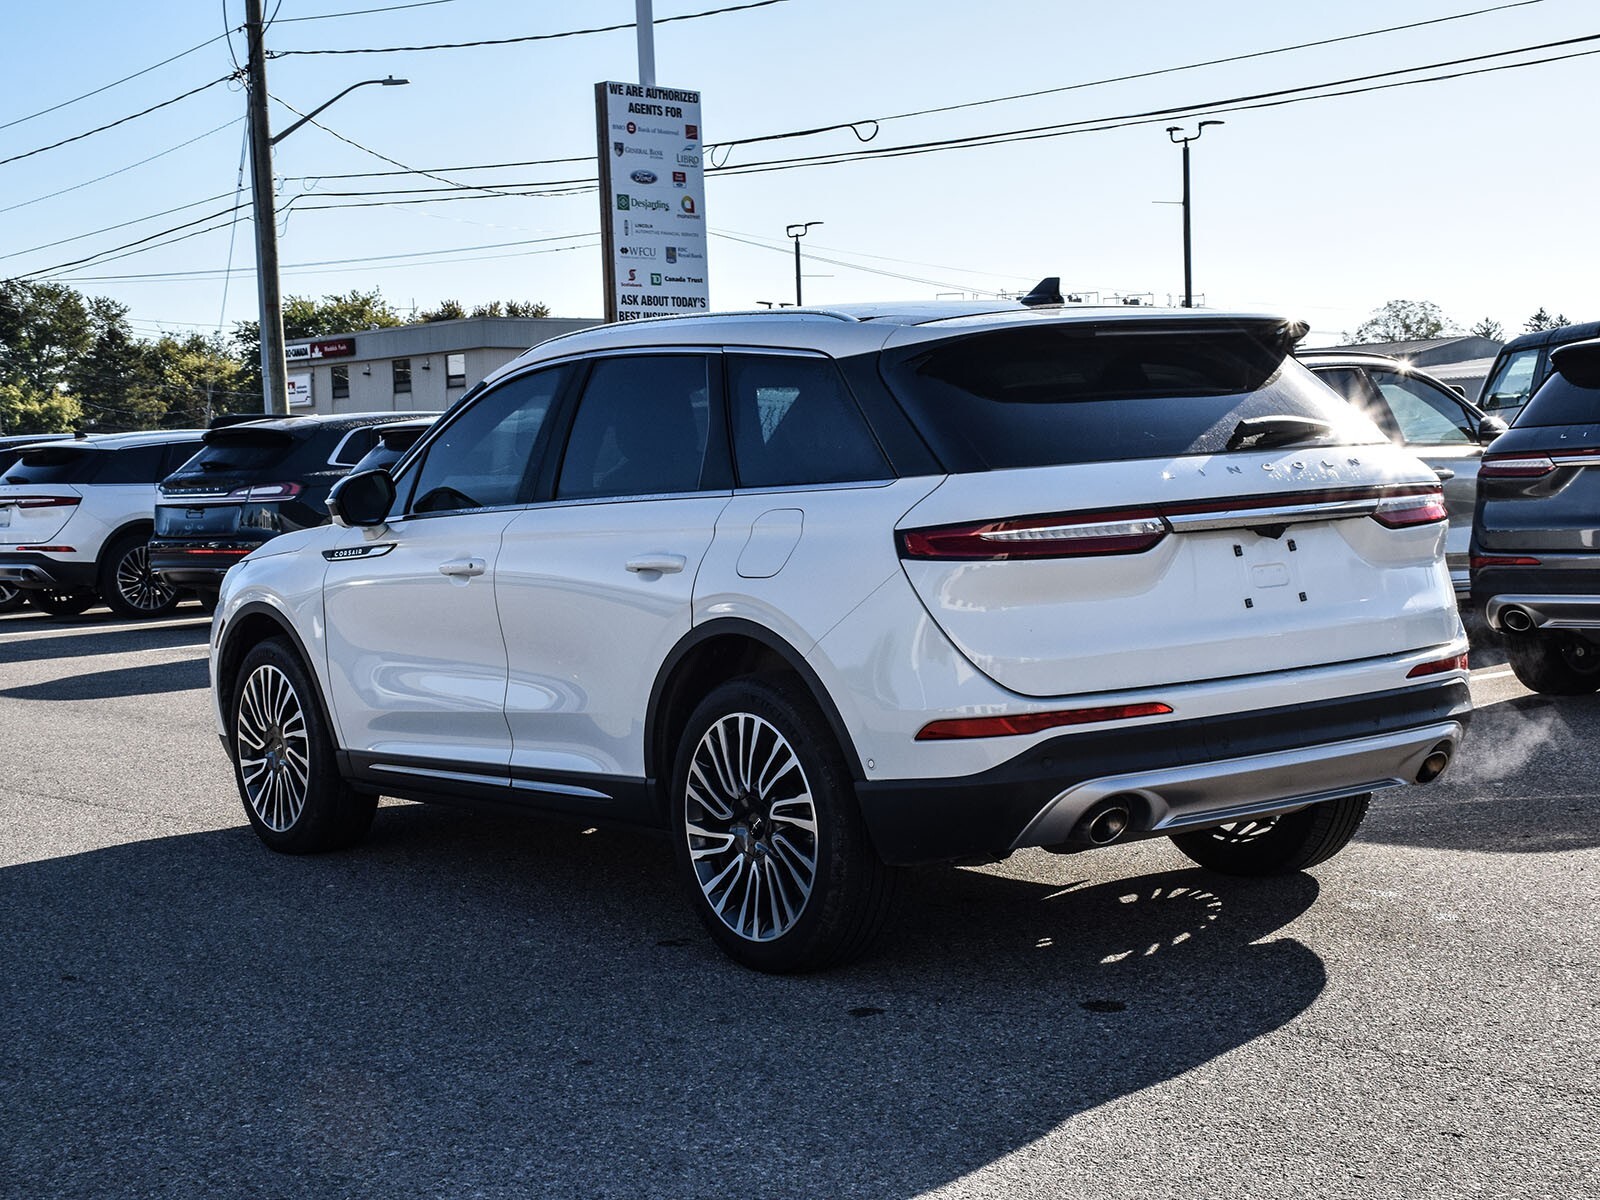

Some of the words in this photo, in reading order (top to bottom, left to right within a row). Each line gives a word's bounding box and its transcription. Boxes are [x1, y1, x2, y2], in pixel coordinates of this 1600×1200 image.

[609, 83, 624, 95] WE
[626, 85, 644, 97] ARE
[646, 88, 699, 103] AUTHORIZED
[628, 103, 663, 116] AGENTS
[665, 107, 683, 118] FOR
[676, 154, 700, 165] LIBRO
[634, 171, 653, 182] Ford
[631, 198, 670, 211] Desjardins
[629, 246, 657, 257] WFCU
[621, 294, 639, 306] ASK
[641, 295, 669, 307] ABOUT
[672, 297, 706, 308] TODAY'S
[618, 311, 641, 321] BEST
[1161, 458, 1361, 479] LINCOLN
[334, 548, 363, 557] CORSAIR
